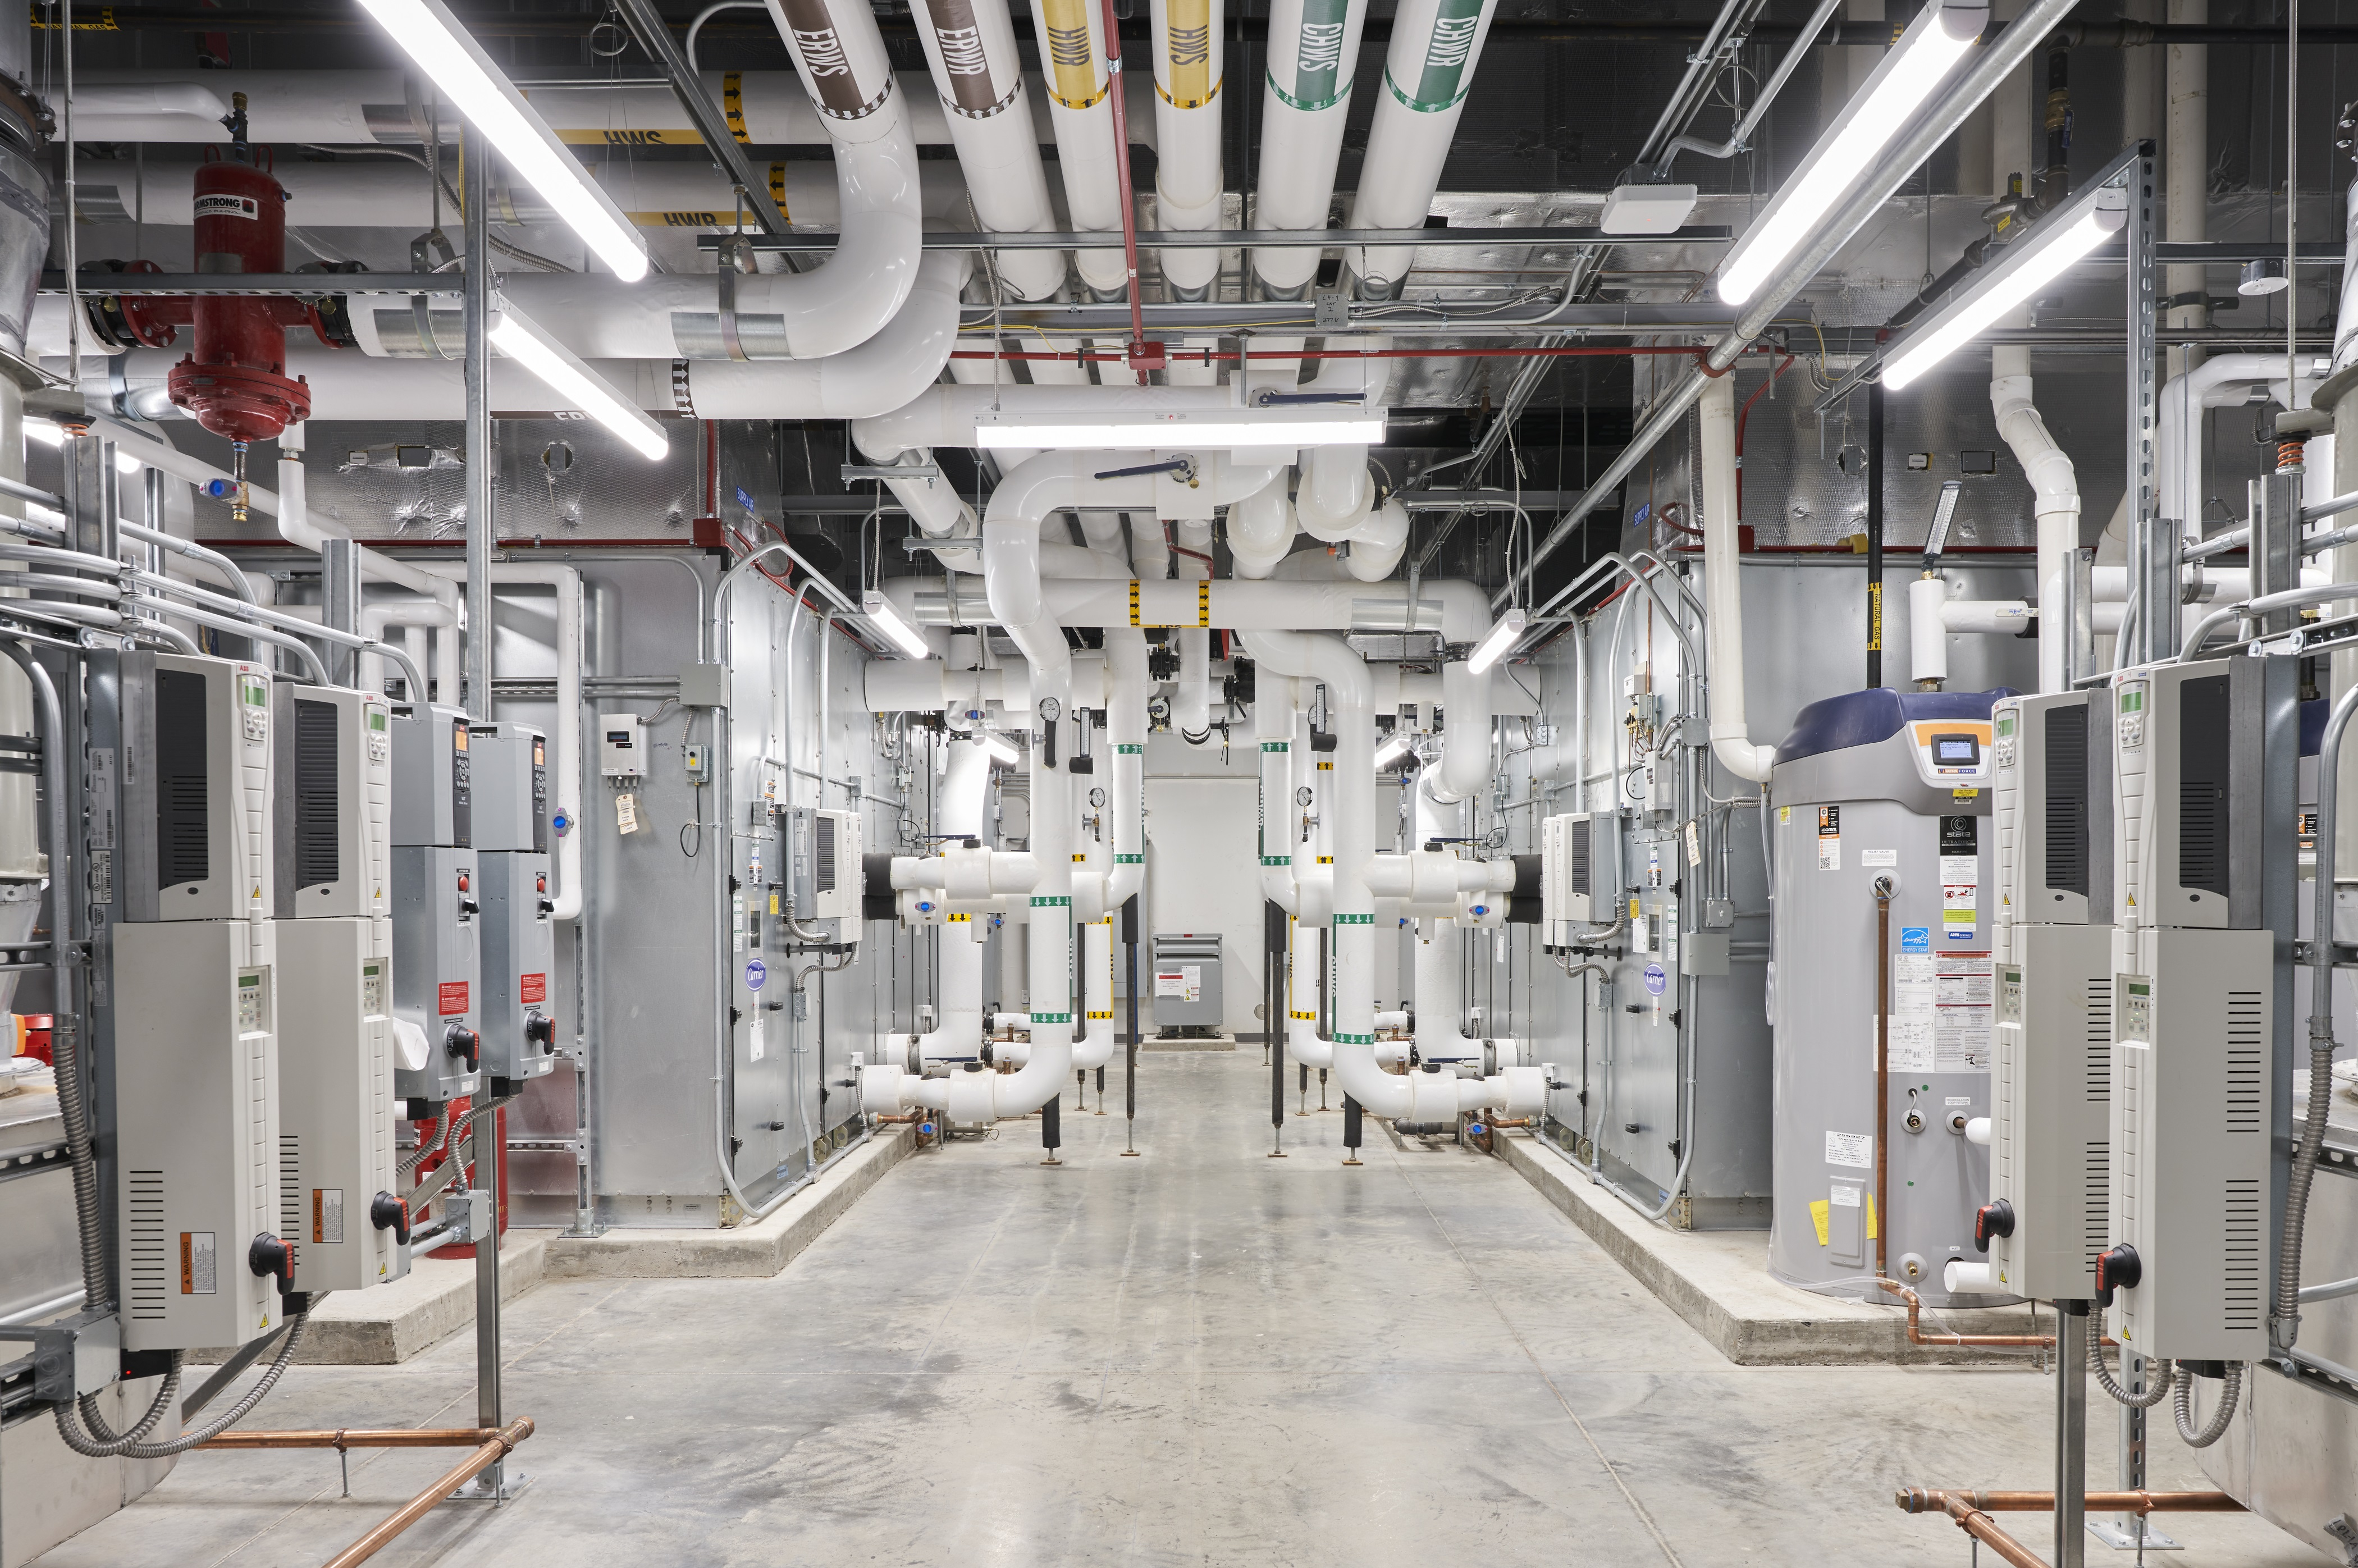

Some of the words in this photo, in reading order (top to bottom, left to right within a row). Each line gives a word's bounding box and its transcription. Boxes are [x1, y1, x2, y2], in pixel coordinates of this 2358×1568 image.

[793, 27, 845, 76] ERWS
[936, 26, 988, 76] ERWR
[1047, 26, 1090, 67] HWR
[1169, 24, 1208, 66] HWS
[1299, 22, 1343, 71] CHWS
[1427, 16, 1478, 67] CHWR
[603, 131, 668, 144] HWS
[663, 213, 719, 226] HWR
[737, 487, 748, 507] SUPPLY
[1634, 507, 1644, 526] SUPPLY
[748, 967, 764, 981] Carrier
[1647, 971, 1664, 986] Carrier
